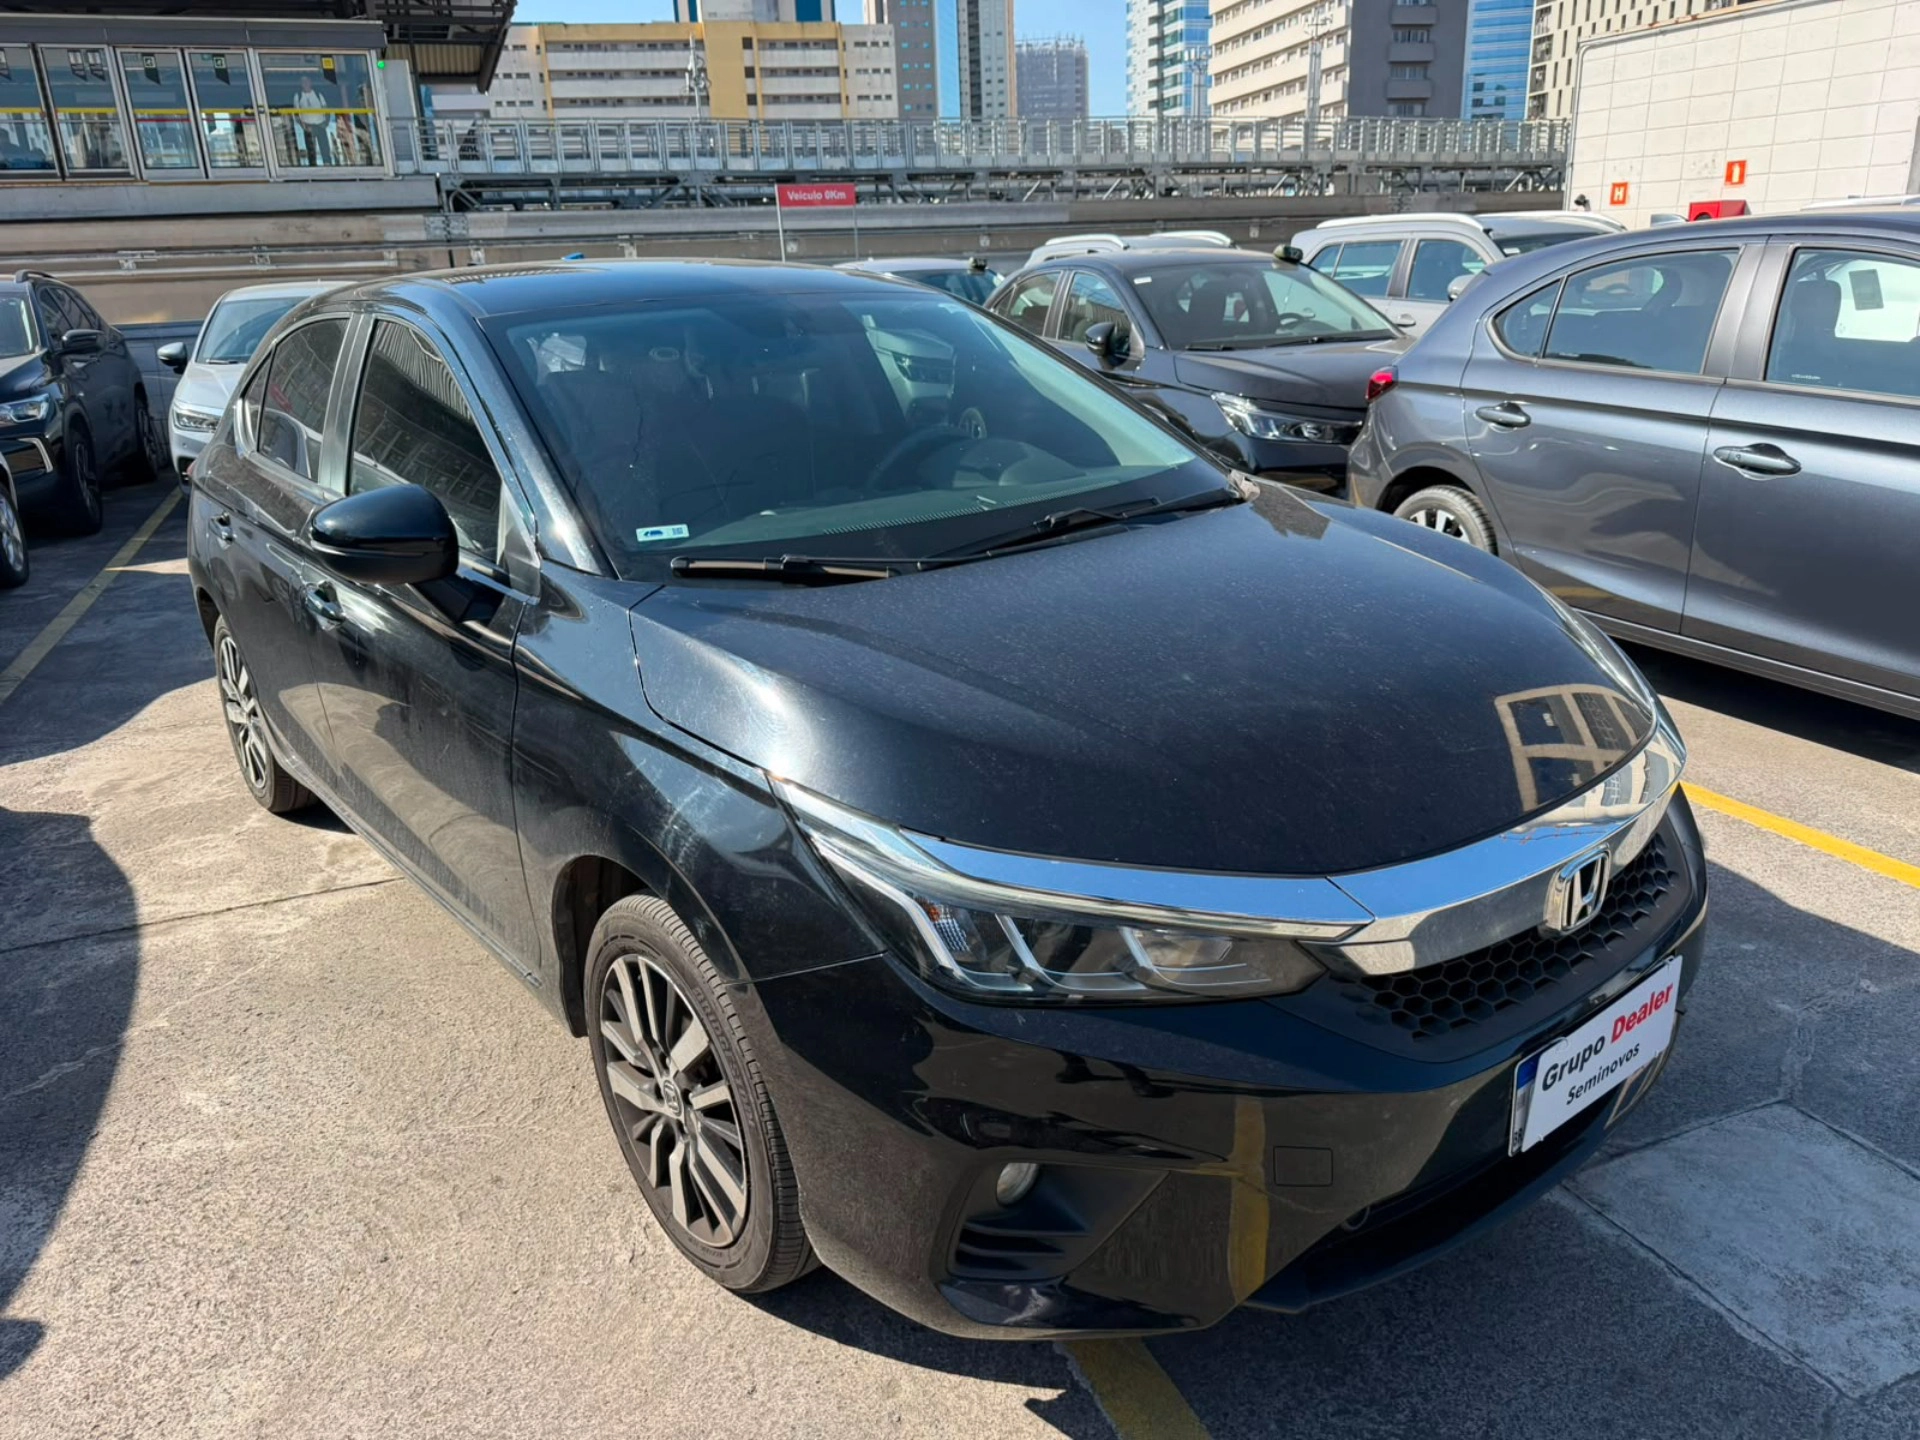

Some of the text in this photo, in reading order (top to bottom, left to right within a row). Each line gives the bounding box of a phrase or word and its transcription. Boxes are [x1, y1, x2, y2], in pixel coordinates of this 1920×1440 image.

[1613, 187, 1625, 201] H
[1542, 982, 1673, 1091] Grupo Dealer
[1566, 1043, 1640, 1105] Seminovos
